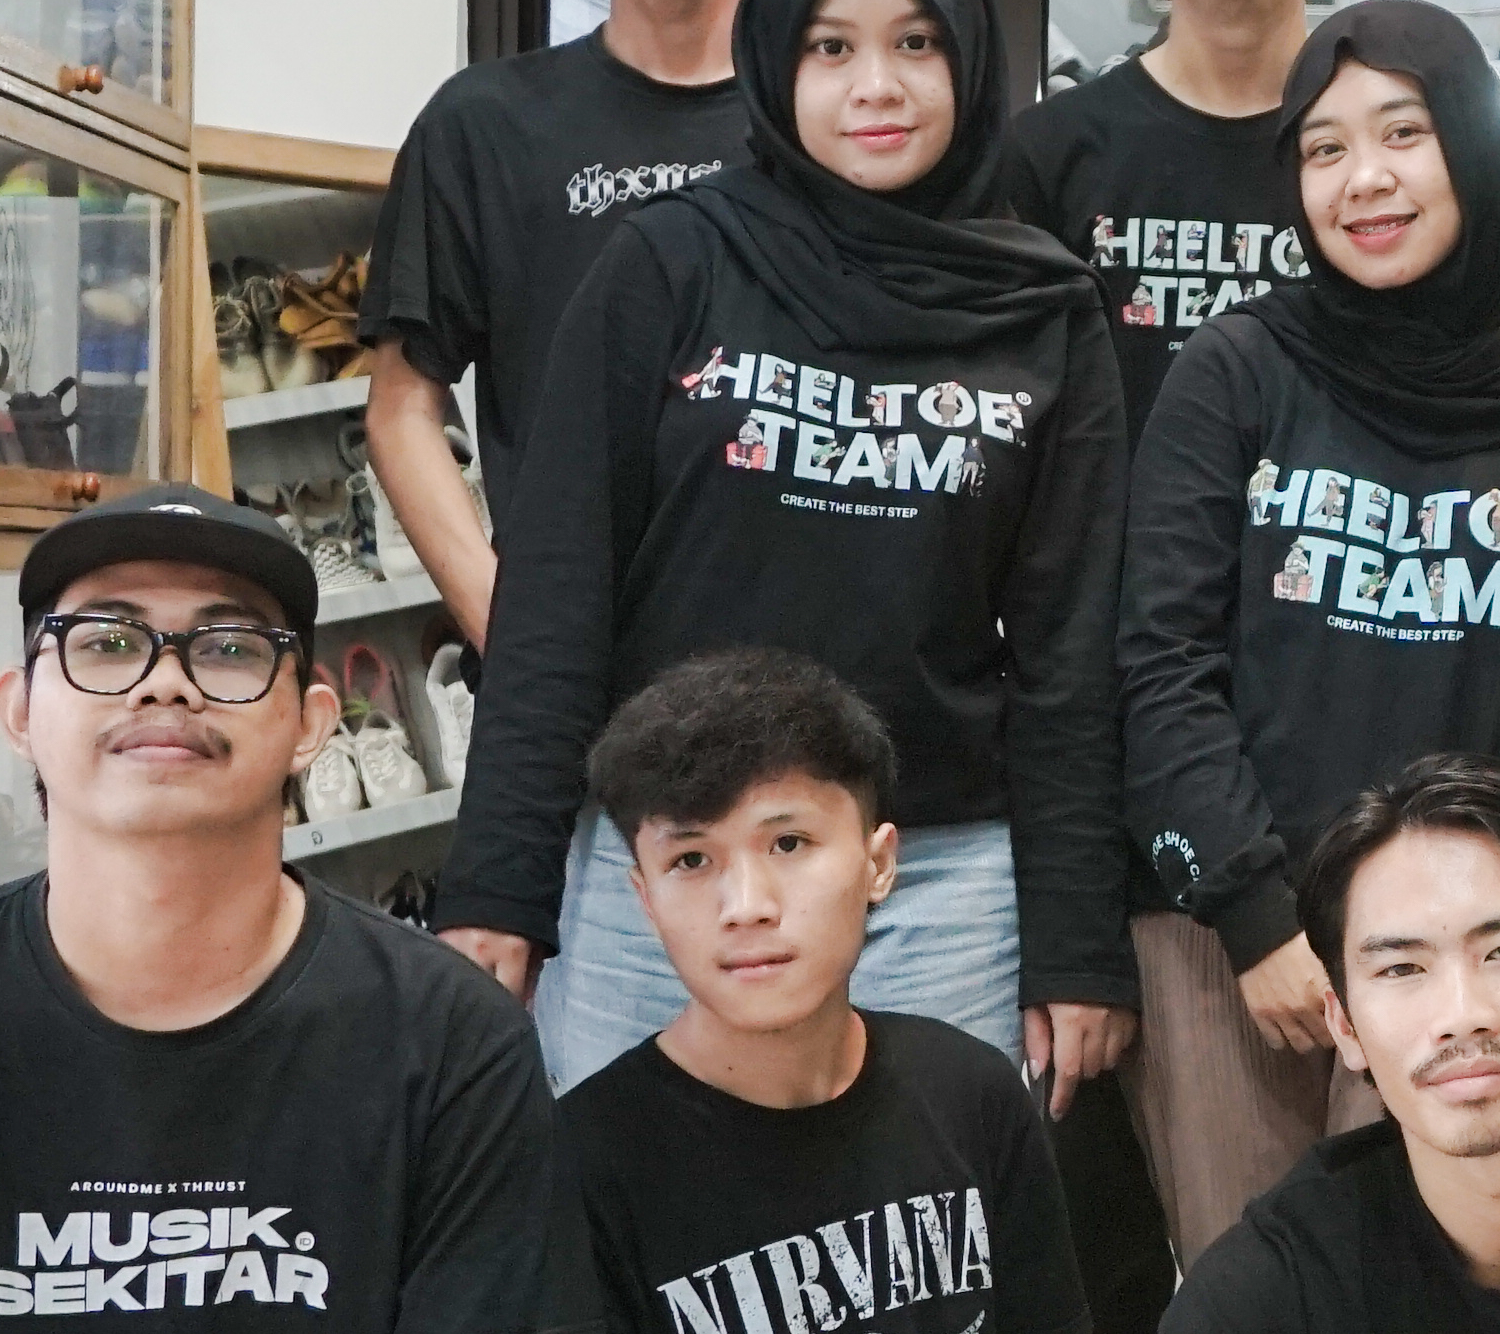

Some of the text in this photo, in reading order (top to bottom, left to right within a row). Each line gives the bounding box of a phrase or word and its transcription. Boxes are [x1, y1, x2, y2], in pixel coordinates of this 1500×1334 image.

[1138, 275, 1272, 327] TEA
[698, 347, 1026, 445] HEELTOE
[749, 408, 968, 495] TEAM
[781, 493, 918, 519] CREATE THE BEST STEP
[1327, 613, 1464, 642] CREATE THE BEST STEP
[70, 1180, 247, 1195] AROUNDME X THRUST
[17, 1206, 293, 1267] MUSIK
